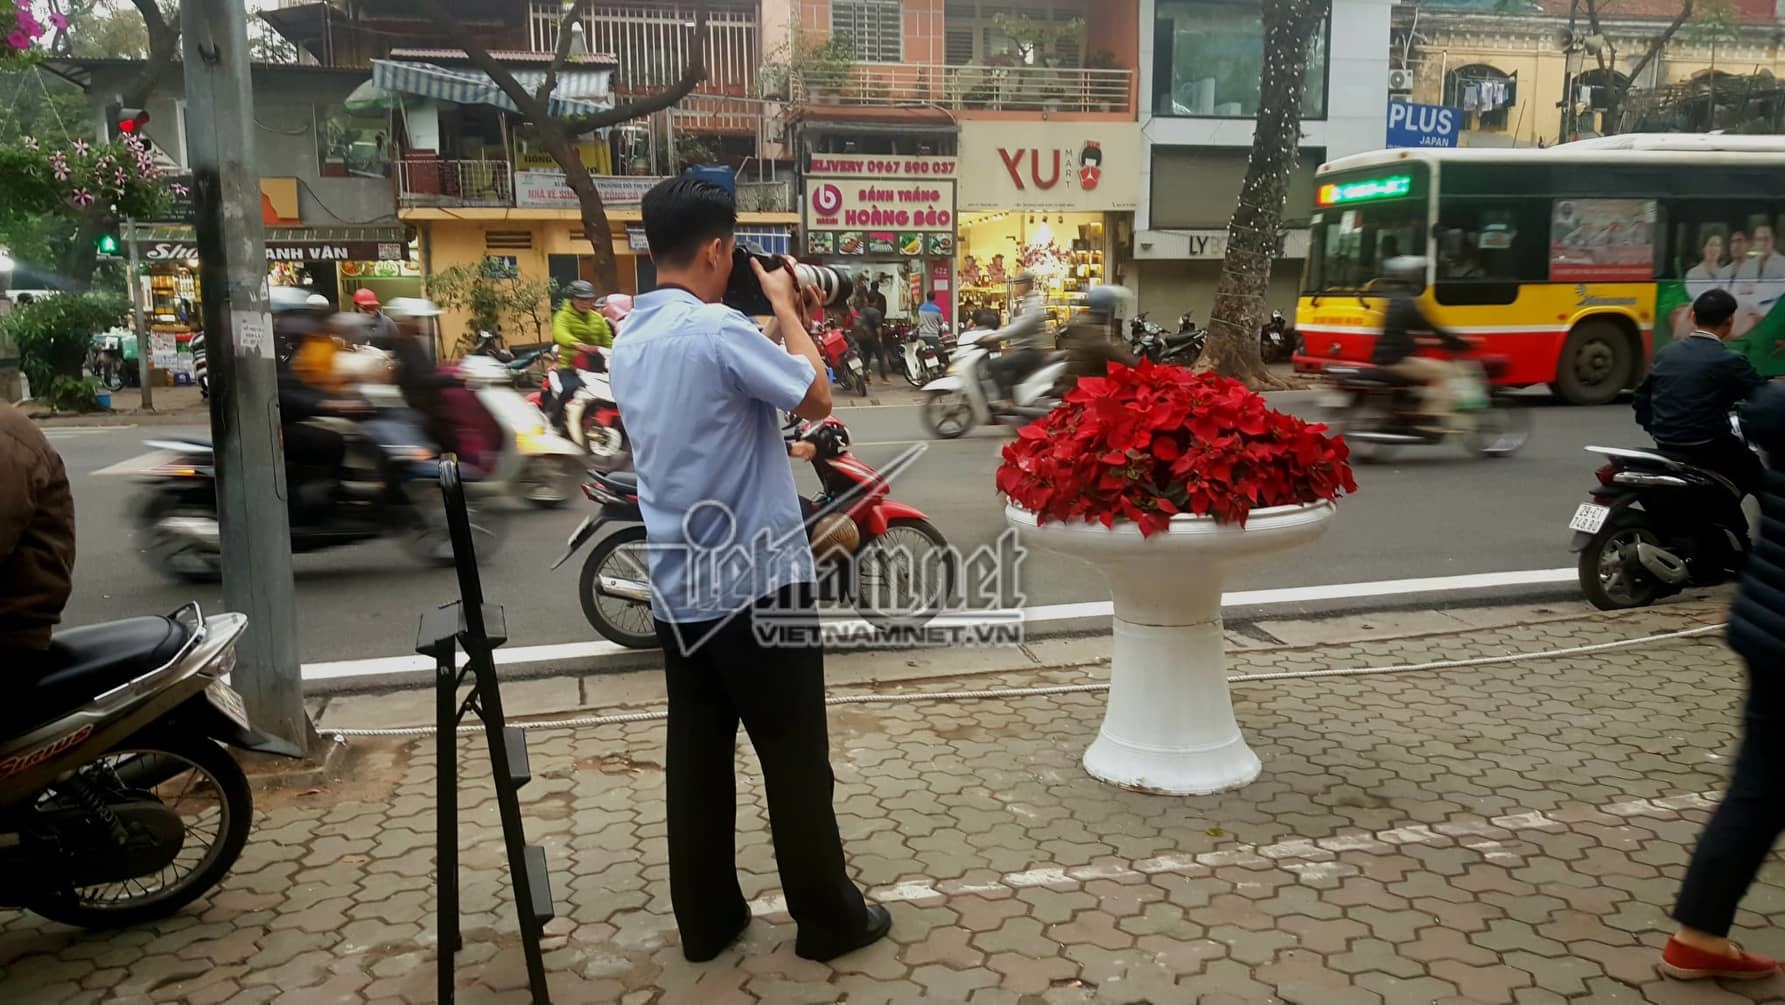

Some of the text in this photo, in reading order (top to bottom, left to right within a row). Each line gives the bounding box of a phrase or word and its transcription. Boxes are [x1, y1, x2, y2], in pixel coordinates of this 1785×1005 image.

[1388, 103, 1453, 135] PLUS
[1419, 135, 1449, 147] JAPAN
[811, 159, 956, 174] ELIVERY 0967 590 037
[997, 148, 1061, 191] YU
[858, 185, 894, 202] BÁNH
[845, 204, 910, 226] HOÀNG
[308, 244, 348, 260] VÂN
